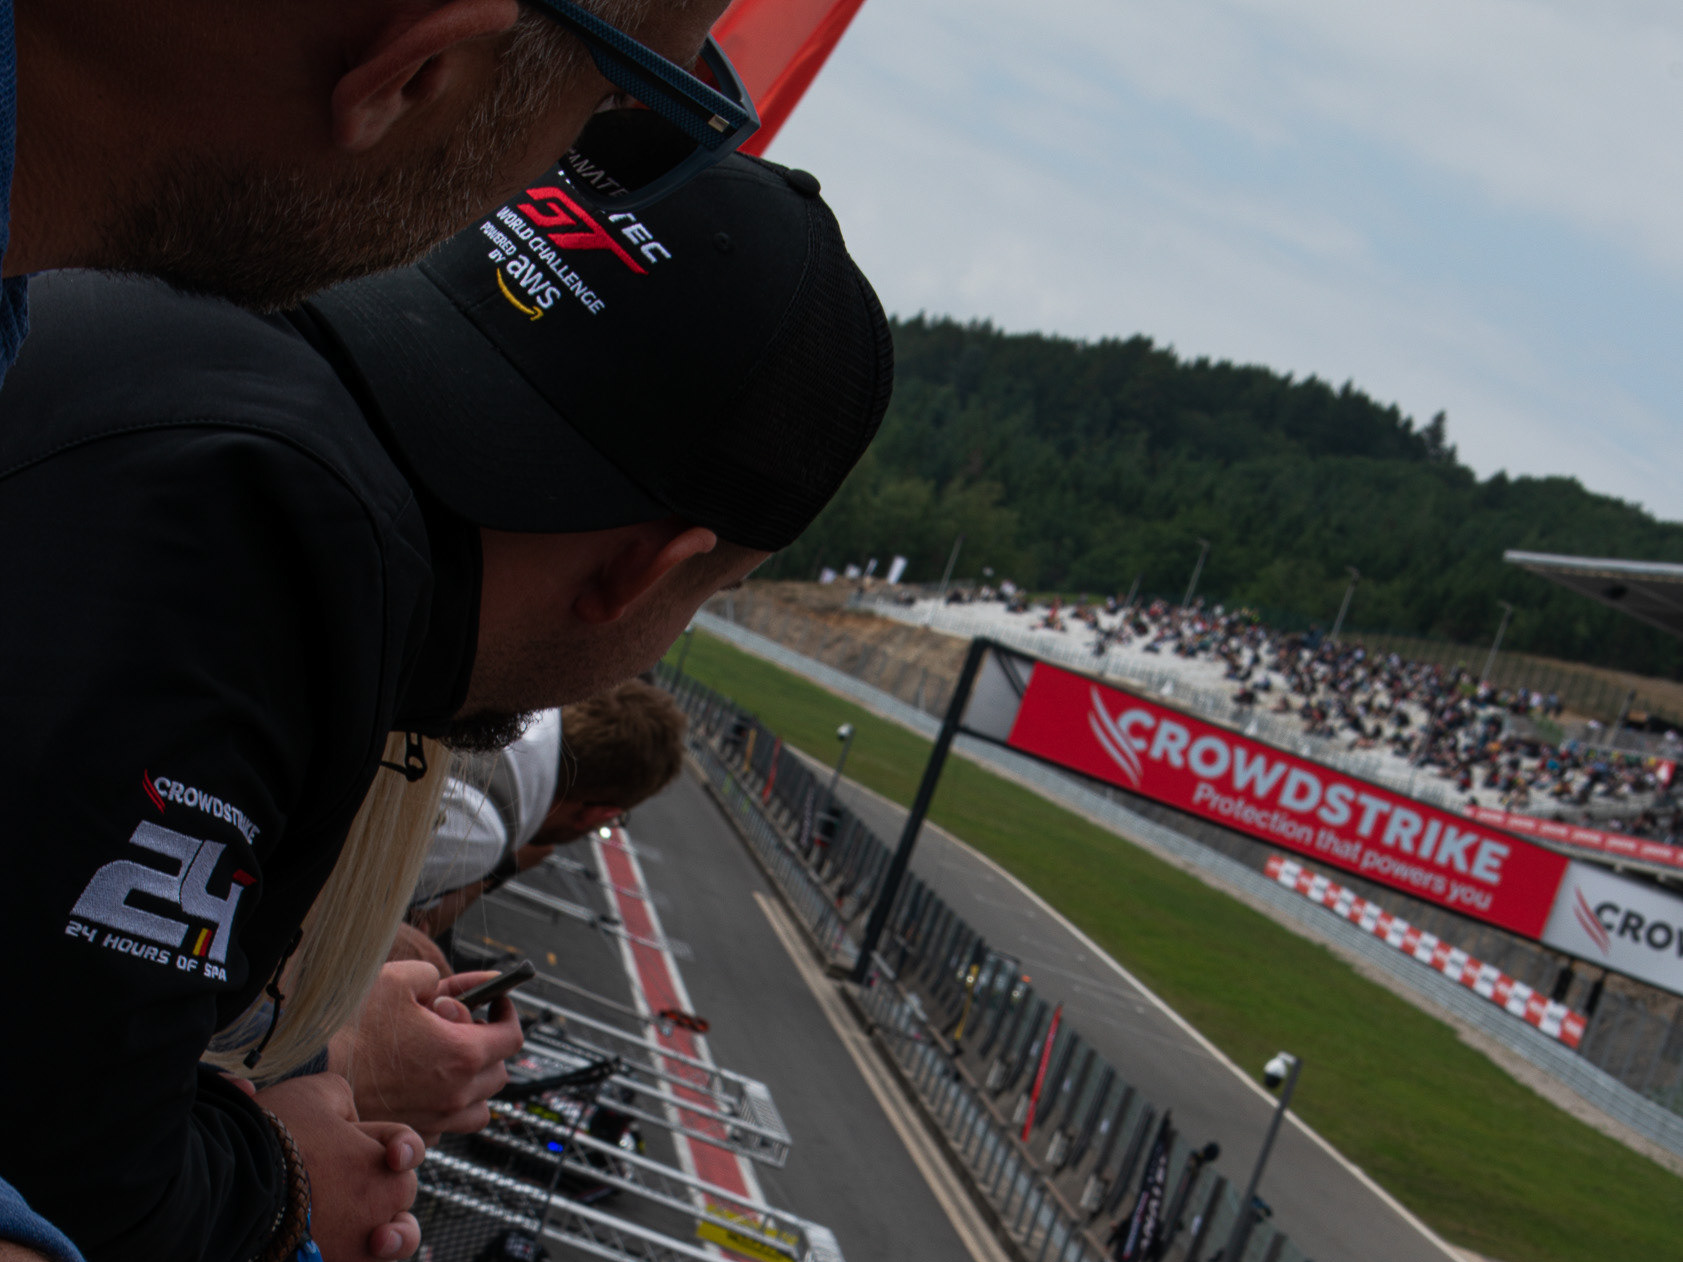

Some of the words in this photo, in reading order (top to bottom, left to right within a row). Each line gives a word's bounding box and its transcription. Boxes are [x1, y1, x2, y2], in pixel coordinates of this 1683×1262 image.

[480, 221, 518, 256] POWERED
[496, 206, 535, 240] WORLD
[528, 237, 606, 315] CHALLENGE
[517, 186, 649, 275] GT
[488, 248, 507, 264] BY
[506, 253, 562, 310] aws
[1116, 707, 1511, 886] CROWDSTRIKE
[1192, 782, 1315, 854] Protection
[1313, 818, 1361, 869] that
[1360, 844, 1444, 896] powers
[1445, 877, 1493, 912] you
[69, 820, 256, 964] 24
[1594, 901, 1683, 958] CRO
[65, 920, 98, 944] 24
[103, 931, 171, 964] HOURS
[176, 955, 199, 973] OF
[204, 965, 228, 982] SPA
